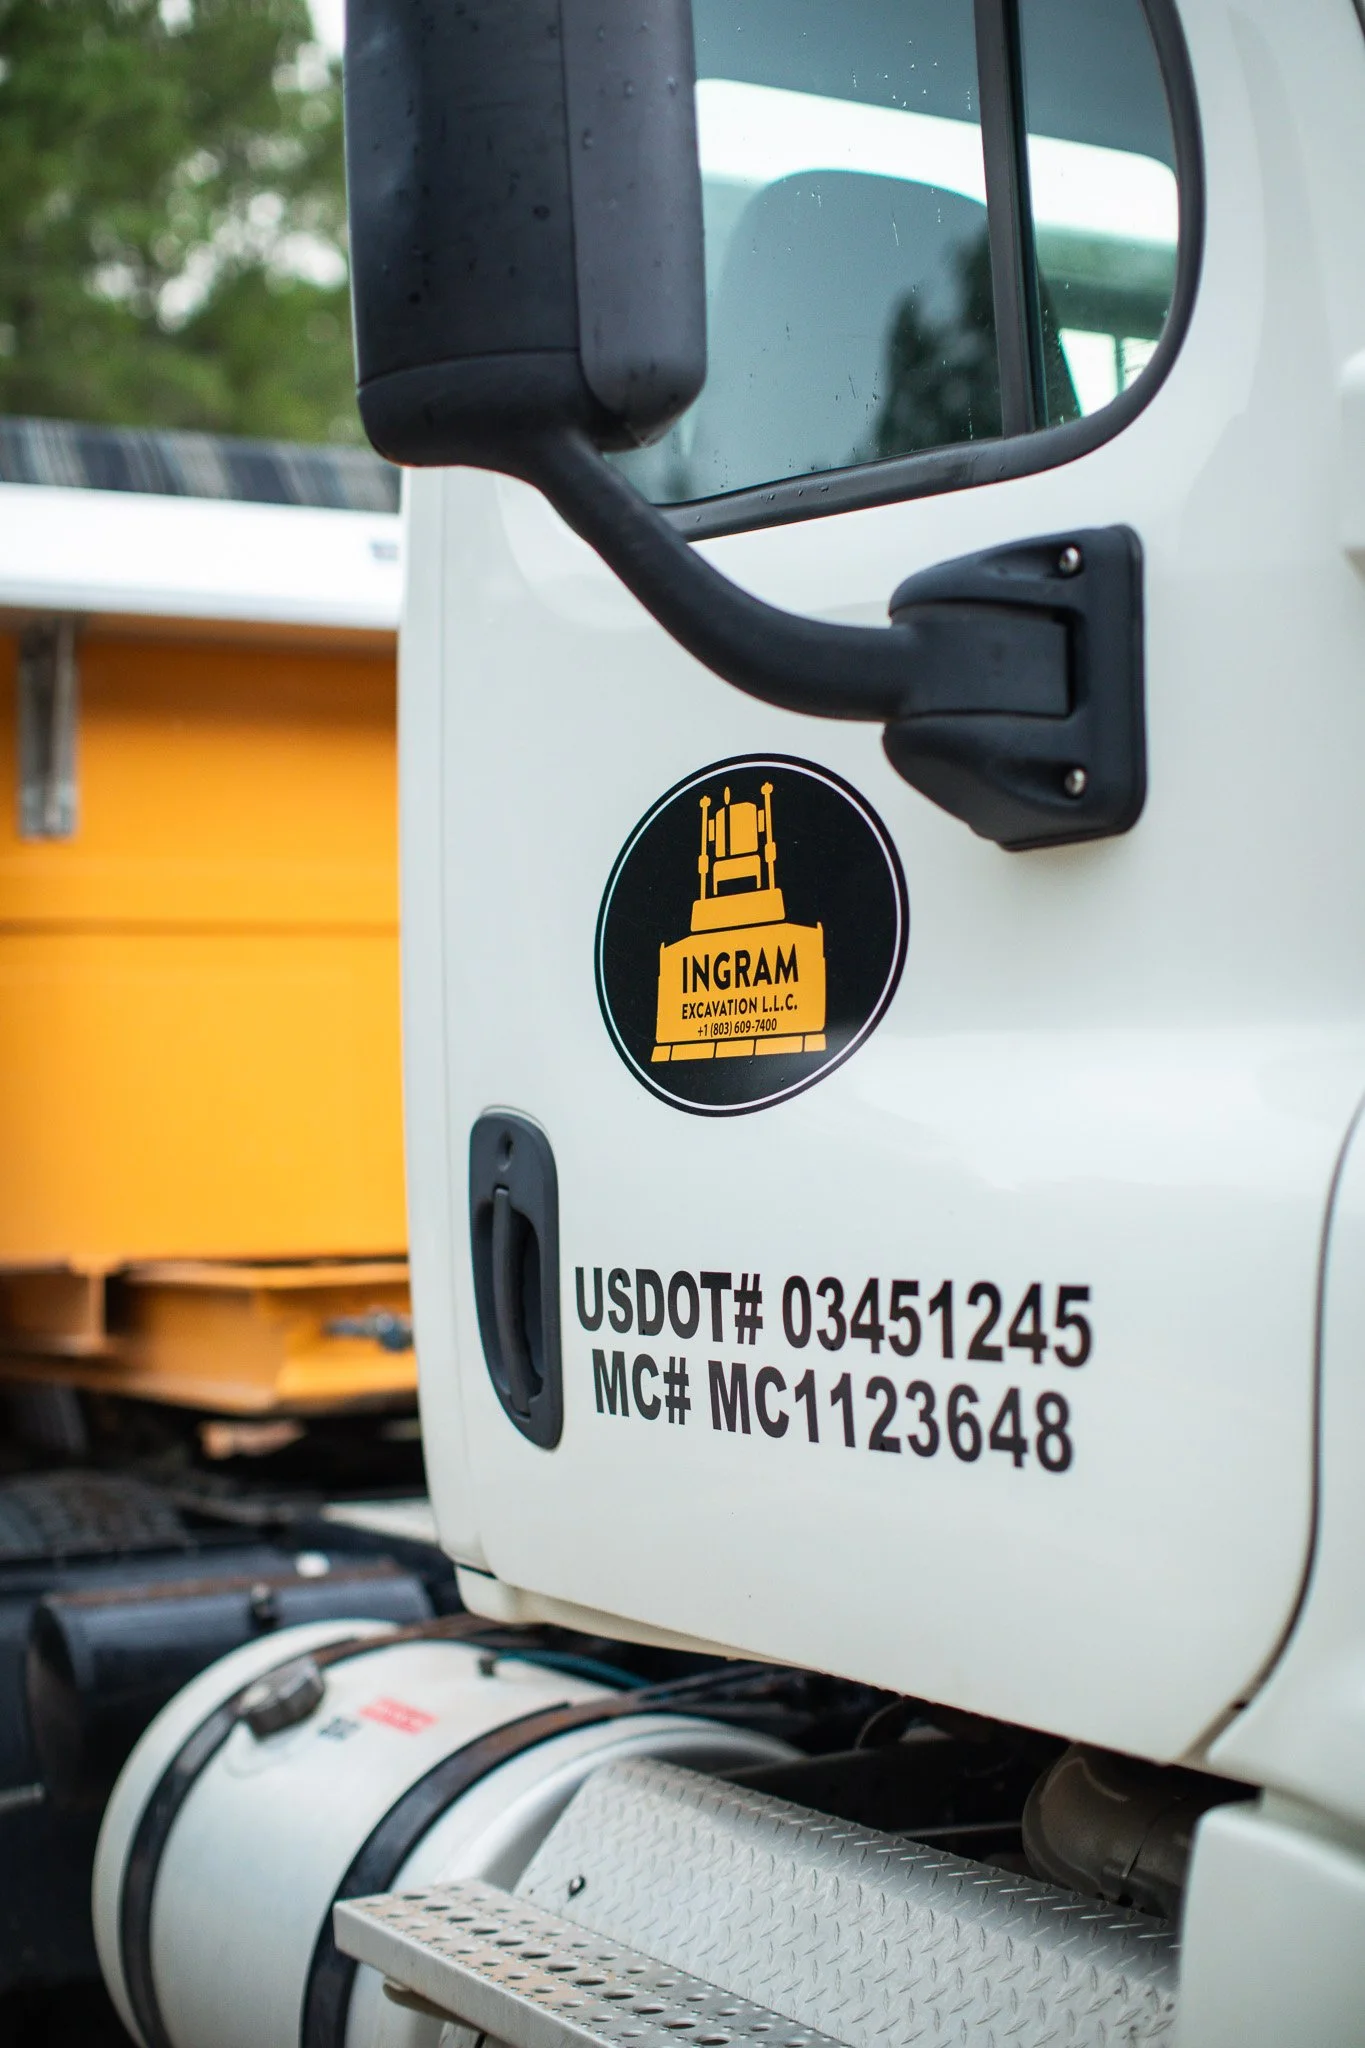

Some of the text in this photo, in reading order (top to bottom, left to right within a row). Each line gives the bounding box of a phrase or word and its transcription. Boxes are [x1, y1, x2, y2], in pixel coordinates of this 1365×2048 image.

[682, 943, 799, 994] INGRAM
[681, 993, 798, 1020] EXCAVATION L.L.C.
[697, 1018, 777, 1038] +1 (803) 609-7400
[575, 1266, 1093, 1368] USDOT# 03451245
[591, 1348, 1073, 1473] MC# MC1123648
